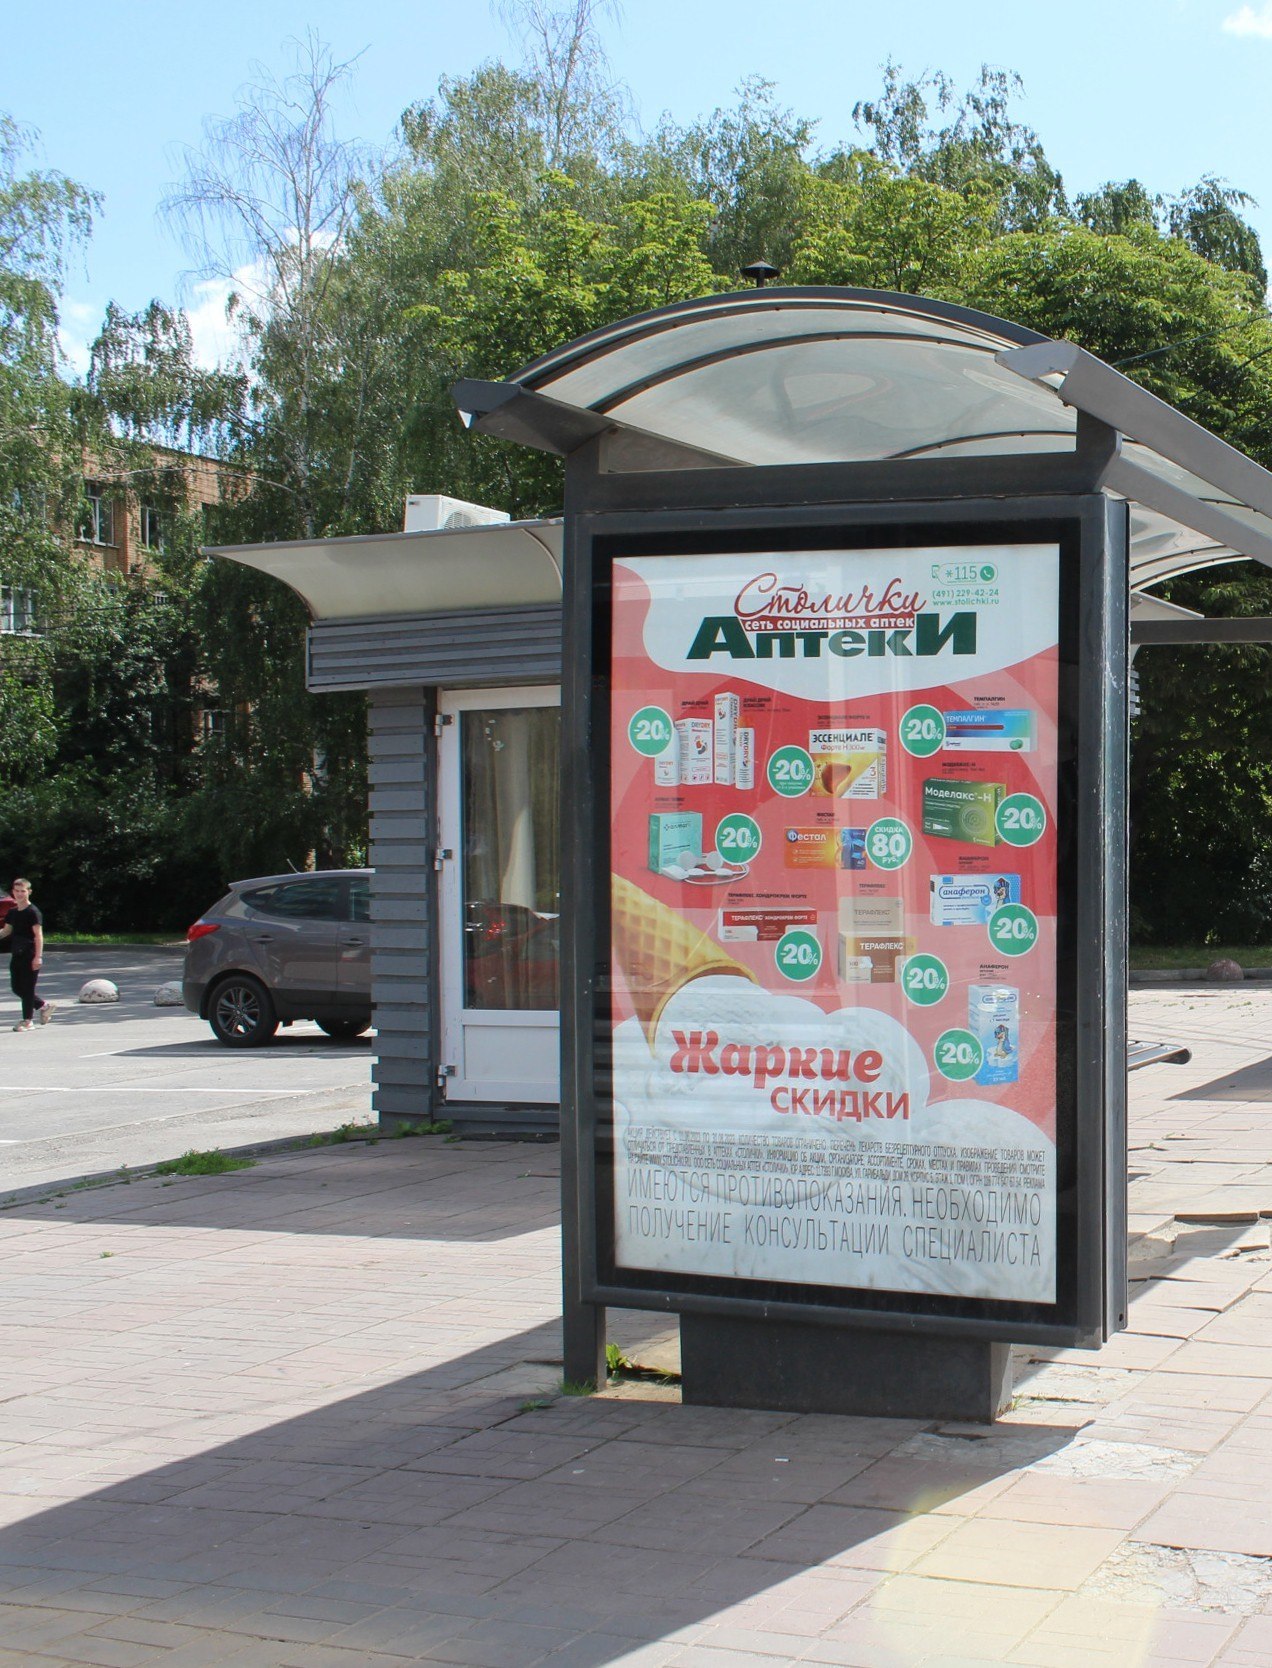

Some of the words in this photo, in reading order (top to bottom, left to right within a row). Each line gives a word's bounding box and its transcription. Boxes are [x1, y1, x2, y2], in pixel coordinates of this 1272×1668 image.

[734, 573, 926, 618] Столички
[933, 590, 954, 599] (491)
[956, 589, 999, 597] 229-42-24
[933, 597, 999, 606] www.stolichki.ru
[745, 620, 773, 631] сеть
[778, 616, 867, 631] социальных
[870, 616, 914, 629] аптек
[634, 719, 670, 740] -20%
[904, 719, 942, 740] -20%
[946, 715, 985, 723] ТЕМПАЛГИН
[812, 732, 873, 743] ЭССЕНЦИАЛЕ
[773, 759, 811, 780] -20%
[1001, 807, 1042, 830] -20%
[720, 827, 757, 848] -20%
[787, 829, 826, 841] Фестал
[874, 826, 903, 834] СКИДКА
[872, 834, 906, 857] 80
[943, 888, 985, 896] анаферон
[994, 917, 1034, 940] -20%
[780, 943, 818, 965] -20%
[860, 942, 904, 950] ТЕРАФЛЕКС
[907, 967, 945, 990] -20%
[670, 1030, 883, 1089] Жаркие
[939, 1042, 979, 1064] -20%
[628, 1167, 709, 1203] ИМЕЮТСЯ
[716, 1173, 907, 1217] ПРОТИВОПОКАЗАНИЯ.
[912, 1186, 1041, 1228] НЕОБХОДИМО
[629, 1205, 732, 1244] ПОЛУЧЕНИЕ
[745, 1213, 889, 1258] КОНСУЛЬТАЦИИ
[902, 1225, 1041, 1266] СПЕЦИАЛИСТА
